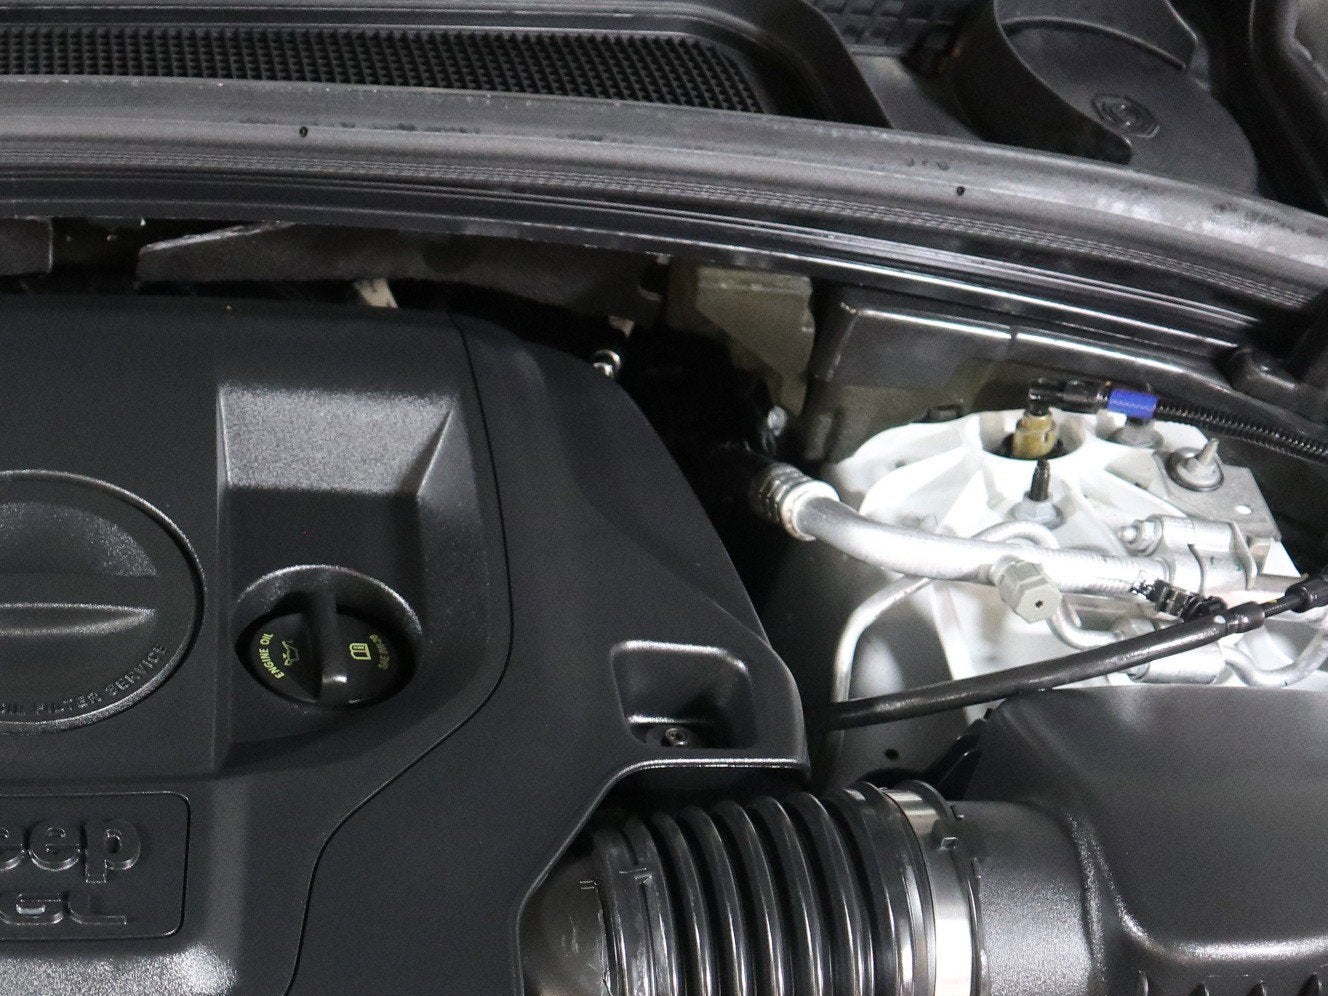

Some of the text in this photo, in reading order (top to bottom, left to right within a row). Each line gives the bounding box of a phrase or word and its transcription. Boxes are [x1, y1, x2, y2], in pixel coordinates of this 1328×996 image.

[35, 692, 102, 716] FILTER
[105, 645, 168, 696] SERVICE
[259, 633, 285, 679] ENGINE OIL
